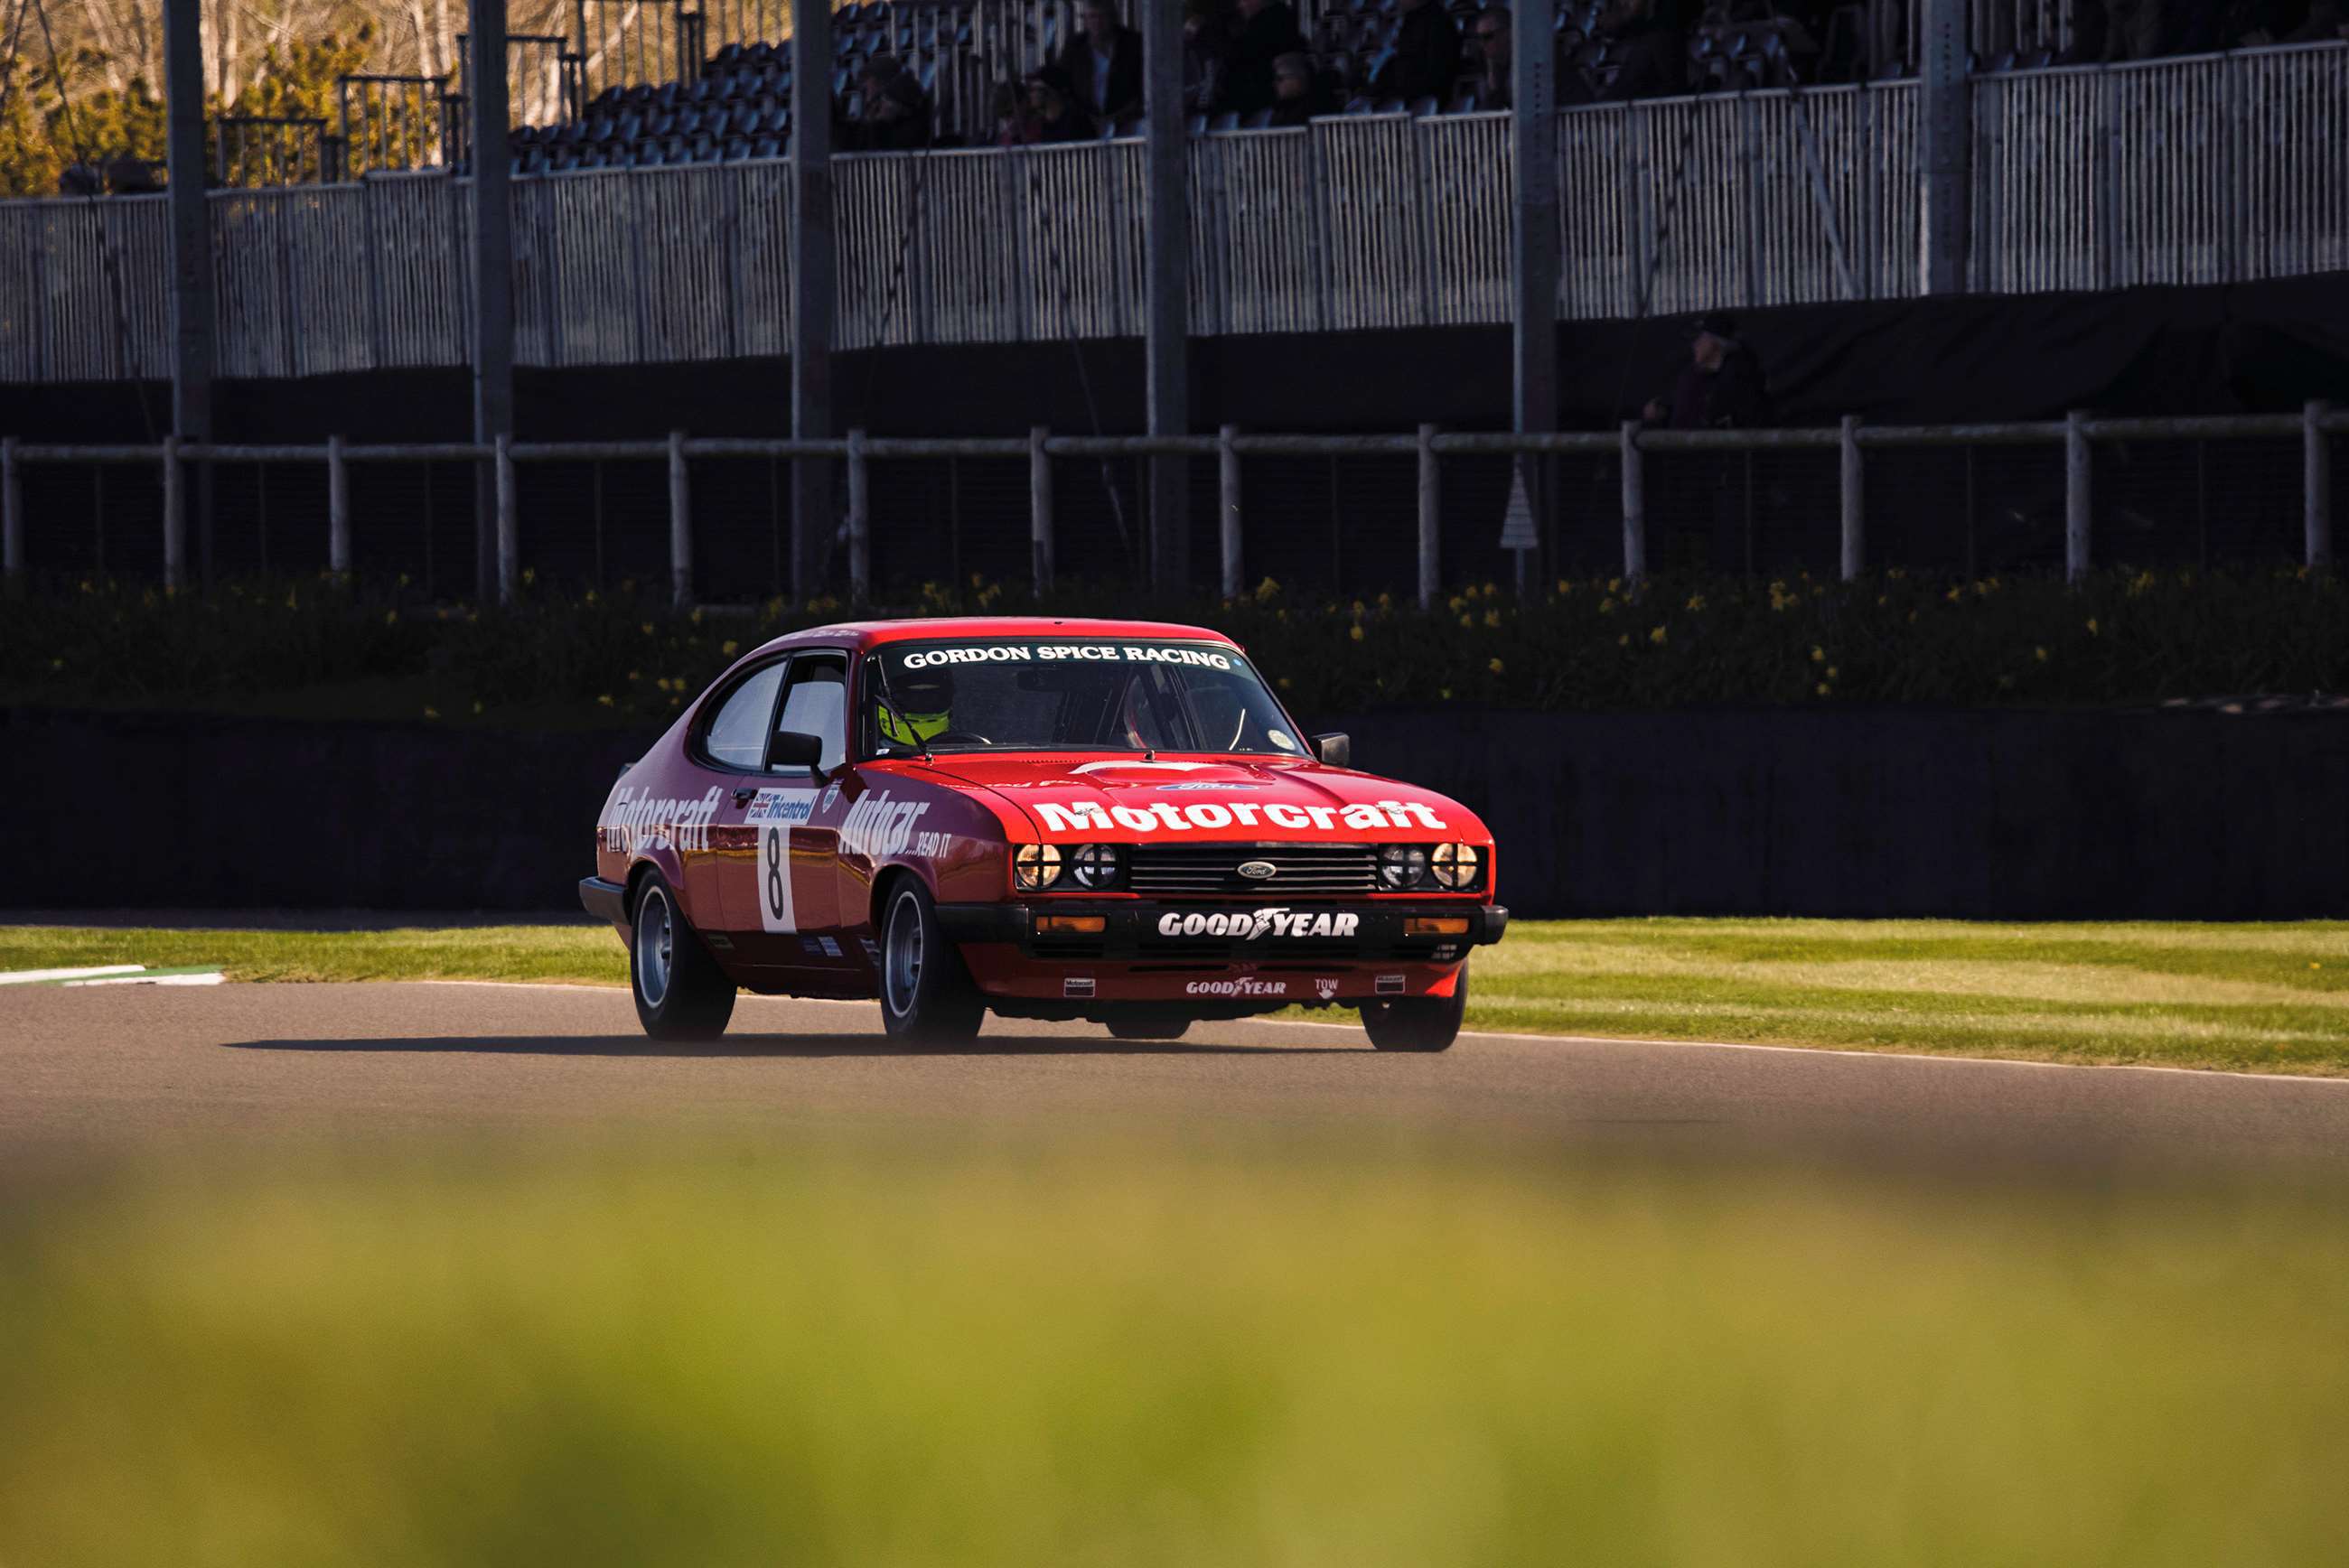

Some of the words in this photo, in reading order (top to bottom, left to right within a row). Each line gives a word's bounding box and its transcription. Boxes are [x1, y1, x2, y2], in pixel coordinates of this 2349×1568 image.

[903, 647, 1032, 669] GORDON
[1036, 647, 1120, 660] SPICE
[1123, 647, 1231, 670] RACING
[607, 786, 723, 853] Motorcraft
[766, 796, 816, 820] Tricentrol
[838, 789, 931, 855] Autocar
[1034, 800, 1447, 833] Motorcraft
[940, 834, 951, 858] IT
[768, 826, 783, 920] 8
[1157, 908, 1359, 940] GOODYEAR
[1186, 977, 1287, 997] GOODYEAR
[1315, 978, 1338, 991] TOW
